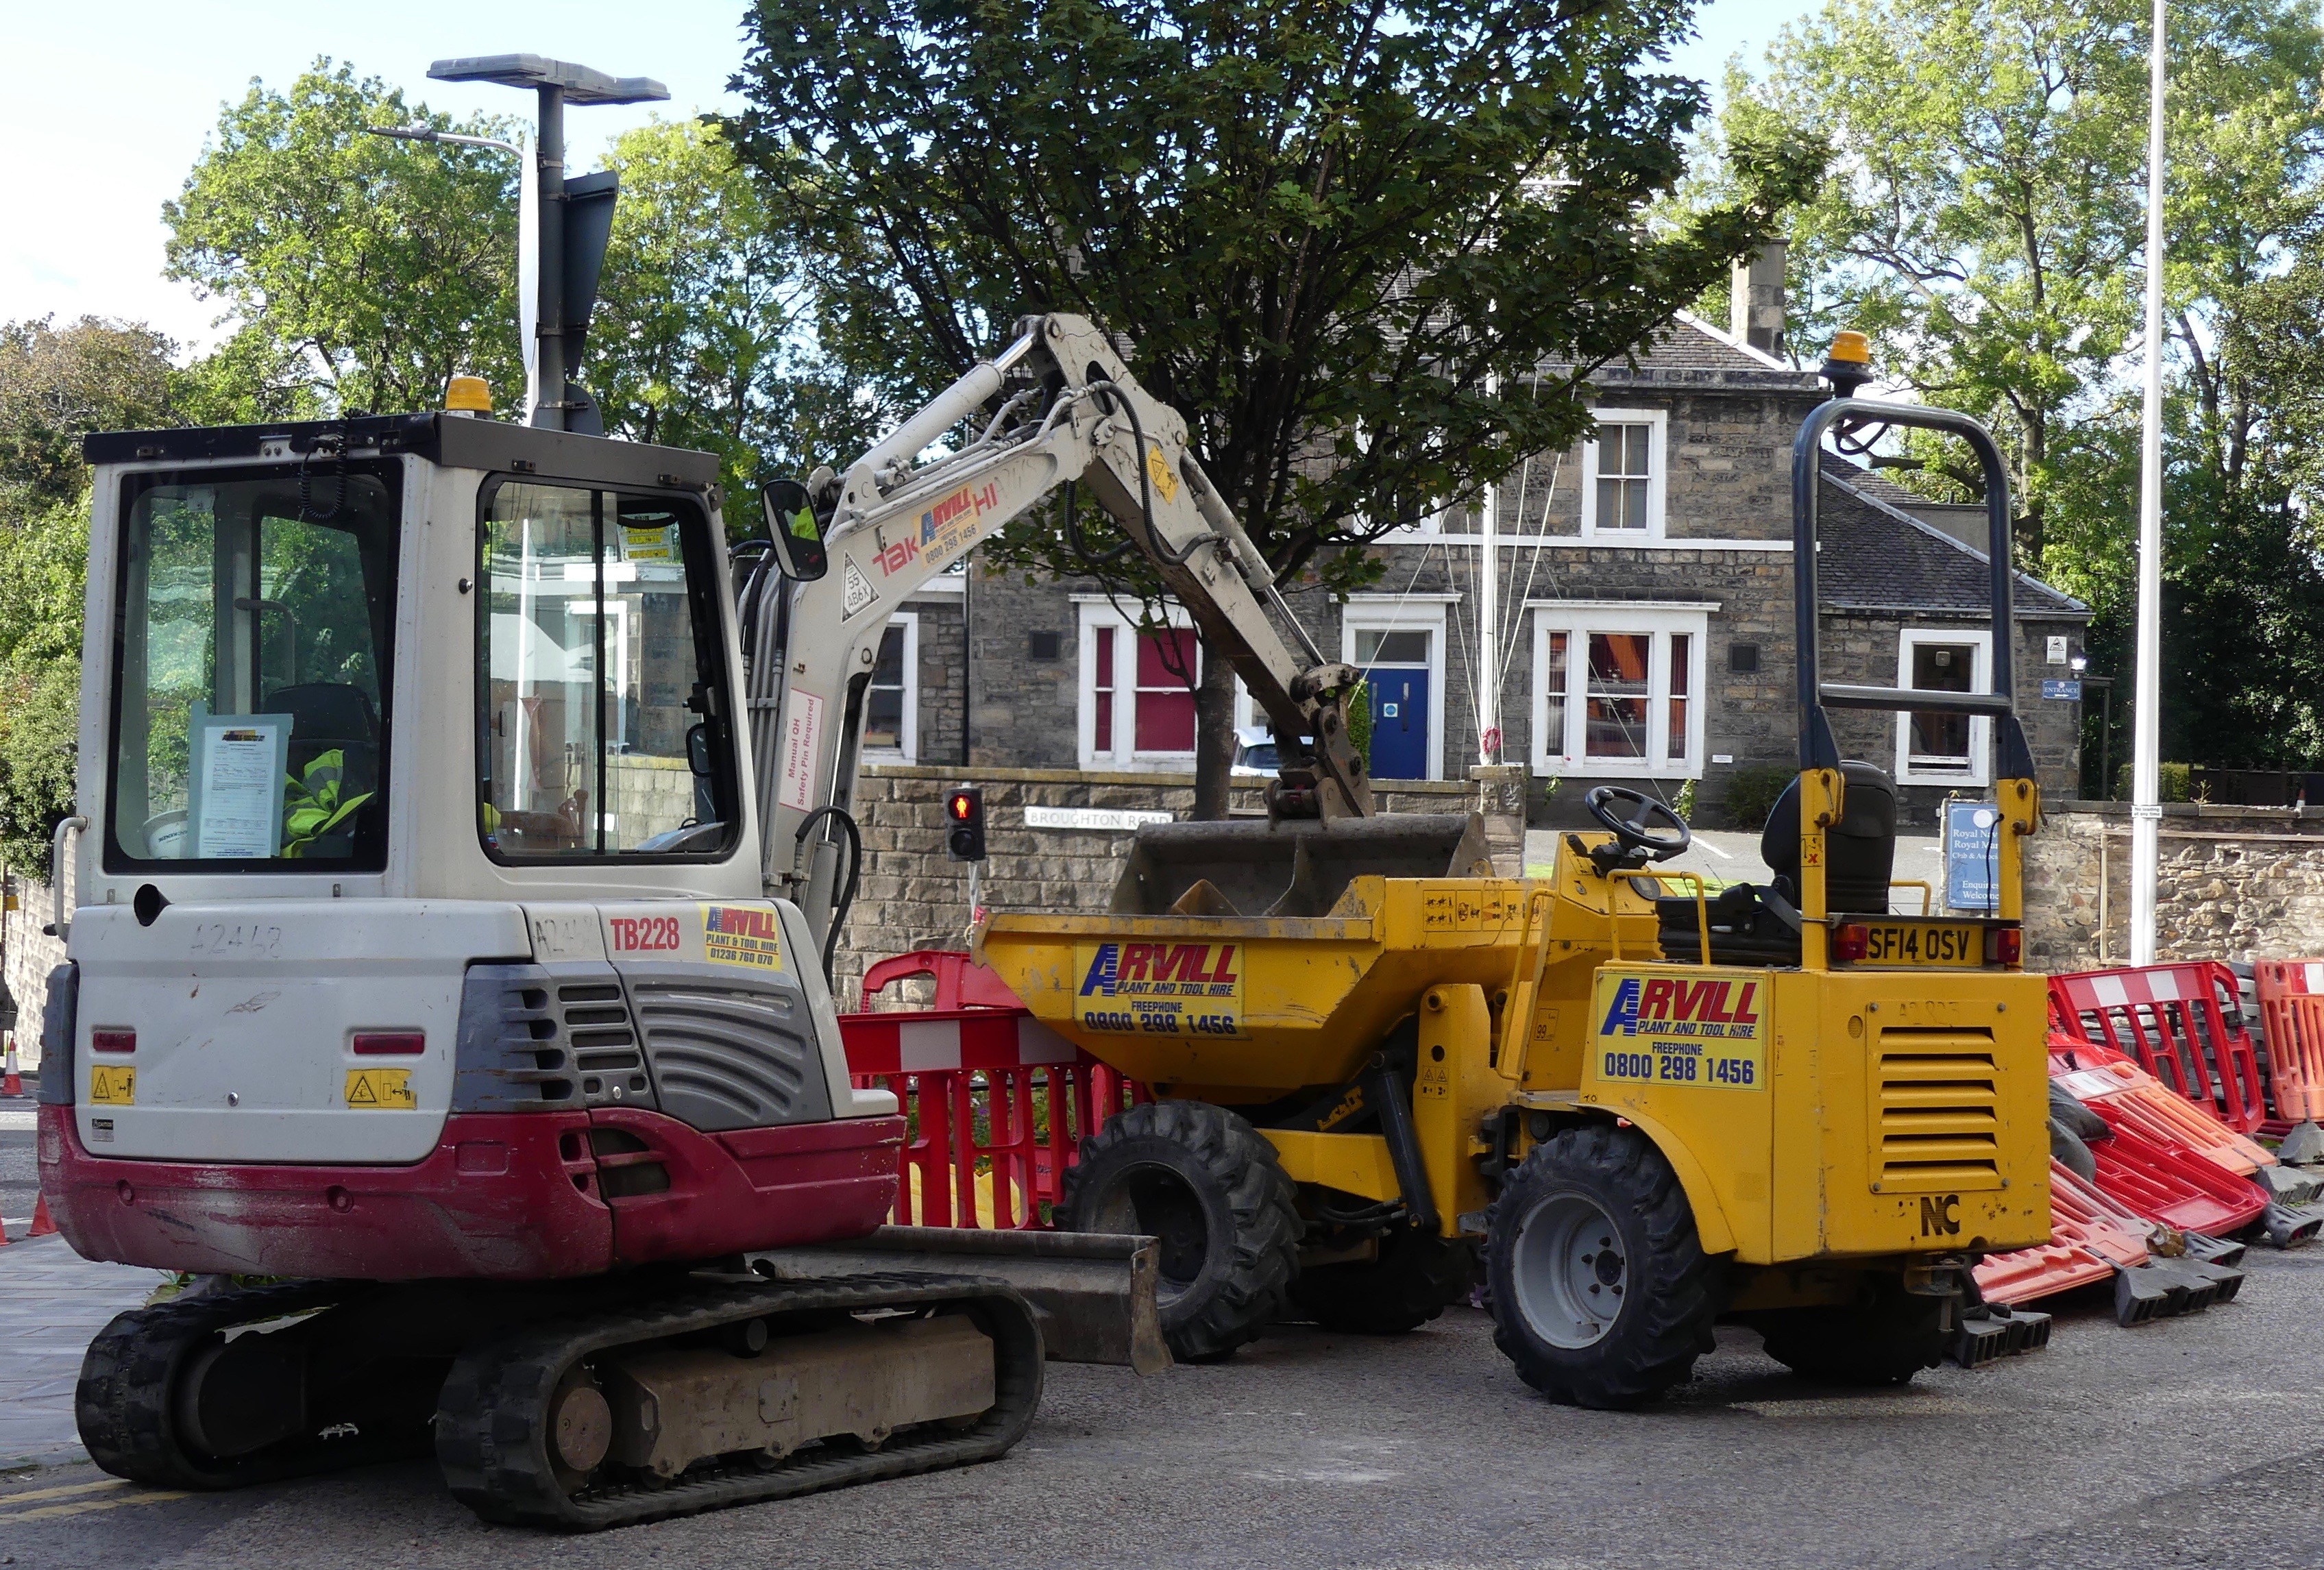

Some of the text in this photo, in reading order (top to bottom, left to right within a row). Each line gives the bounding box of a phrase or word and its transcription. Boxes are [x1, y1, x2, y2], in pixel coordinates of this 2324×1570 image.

[925, 524, 977, 564] 0800 298 1456
[847, 572, 860, 590] 55
[788, 718, 800, 778] Manual QH
[798, 698, 814, 806] Safety Pin Required
[1031, 812, 1123, 826] BROUGHTON
[1953, 829, 1978, 839] Royal
[1954, 841, 1979, 850] Royal
[610, 917, 680, 950] TB228
[706, 906, 775, 941] ARVILL
[706, 933, 779, 952] PLANT & TOOL HIRE
[1868, 928, 1970, 960] SF14 OSV
[711, 948, 773, 966] 01236 760 070
[1078, 943, 1237, 997] ARVILL
[1116, 981, 1234, 995] PLANT AND TOOL HIRE
[1132, 1001, 1182, 1013] FREEPHONE
[1600, 978, 1759, 1037] ARVILL
[1084, 1011, 1237, 1034] 0800 298 1456
[1637, 1021, 1754, 1038] PLANT AND TOOL HIRE
[1652, 1042, 1703, 1056] FREEPHONE
[1604, 1053, 1754, 1085] 0800 298 1456
[1920, 1194, 1960, 1237] NC
